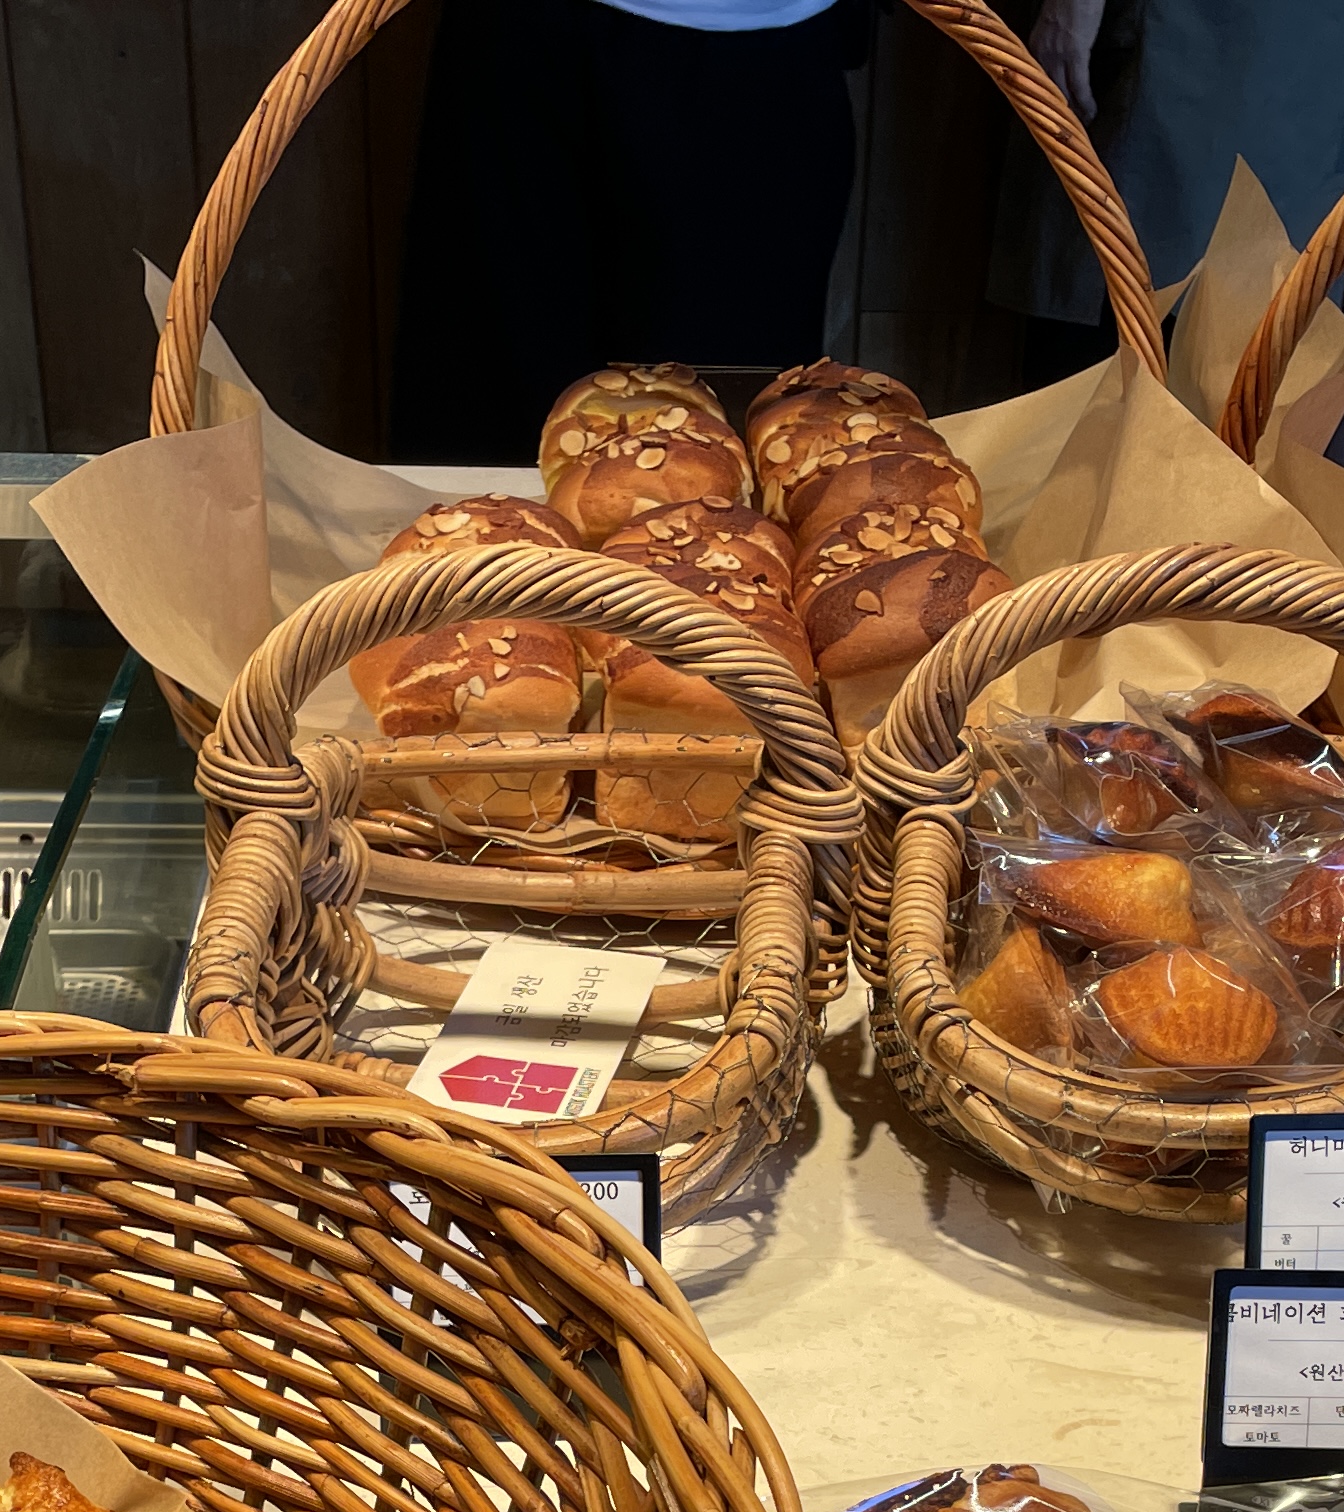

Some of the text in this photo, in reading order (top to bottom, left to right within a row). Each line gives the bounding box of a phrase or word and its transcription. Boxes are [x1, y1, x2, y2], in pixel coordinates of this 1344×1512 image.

[495, 974, 543, 1026] 금일 생산
[550, 966, 610, 1048] 마감되었습니다
[1243, 1431, 1281, 1443] 토마토
